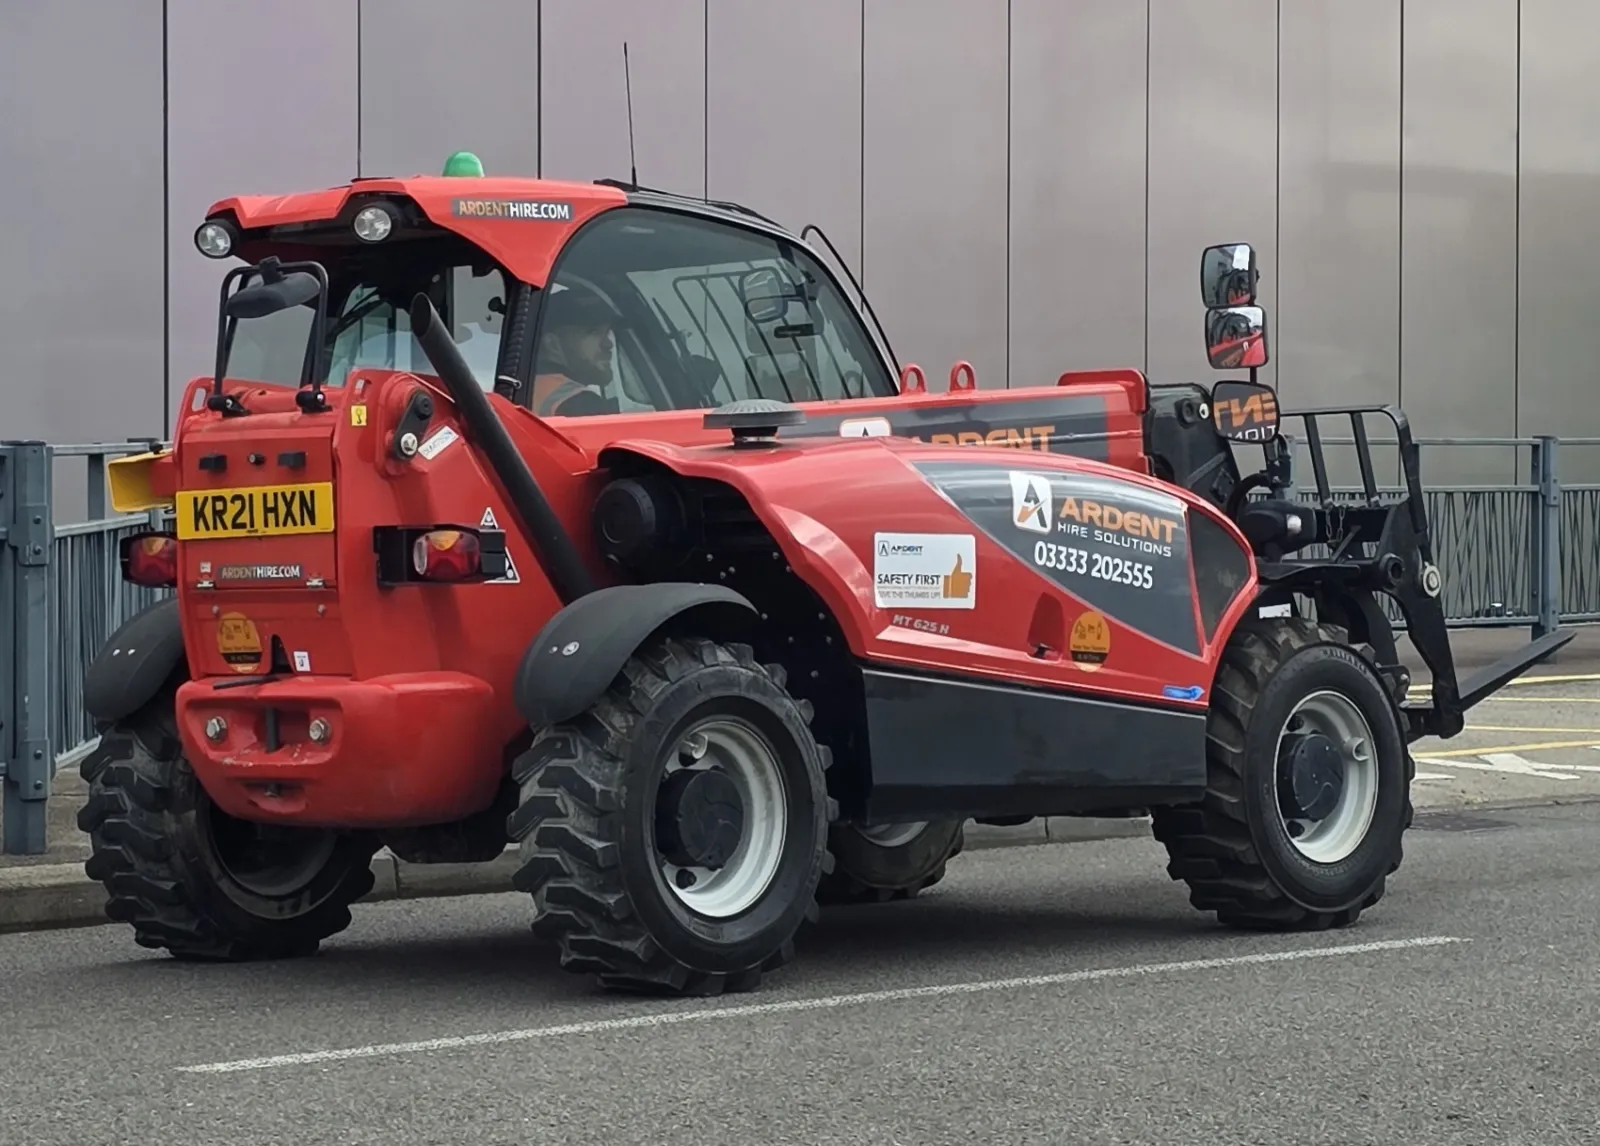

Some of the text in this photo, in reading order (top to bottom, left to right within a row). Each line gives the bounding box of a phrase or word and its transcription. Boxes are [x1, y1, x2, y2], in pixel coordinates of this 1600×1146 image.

[459, 200, 570, 219] ARDENTHIRE.COM
[917, 425, 1055, 453] DENT
[193, 489, 316, 532] KR21 HXN
[1059, 496, 1178, 544] ARDENT
[1057, 521, 1172, 557] HIRE SOLUTIONS
[221, 565, 300, 579] ARDENTHIRE.COM
[1034, 540, 1153, 589] 03333 202555
[877, 573, 941, 585] SAFETY FIRST
[892, 614, 912, 626] MT
[913, 619, 937, 632] 625
